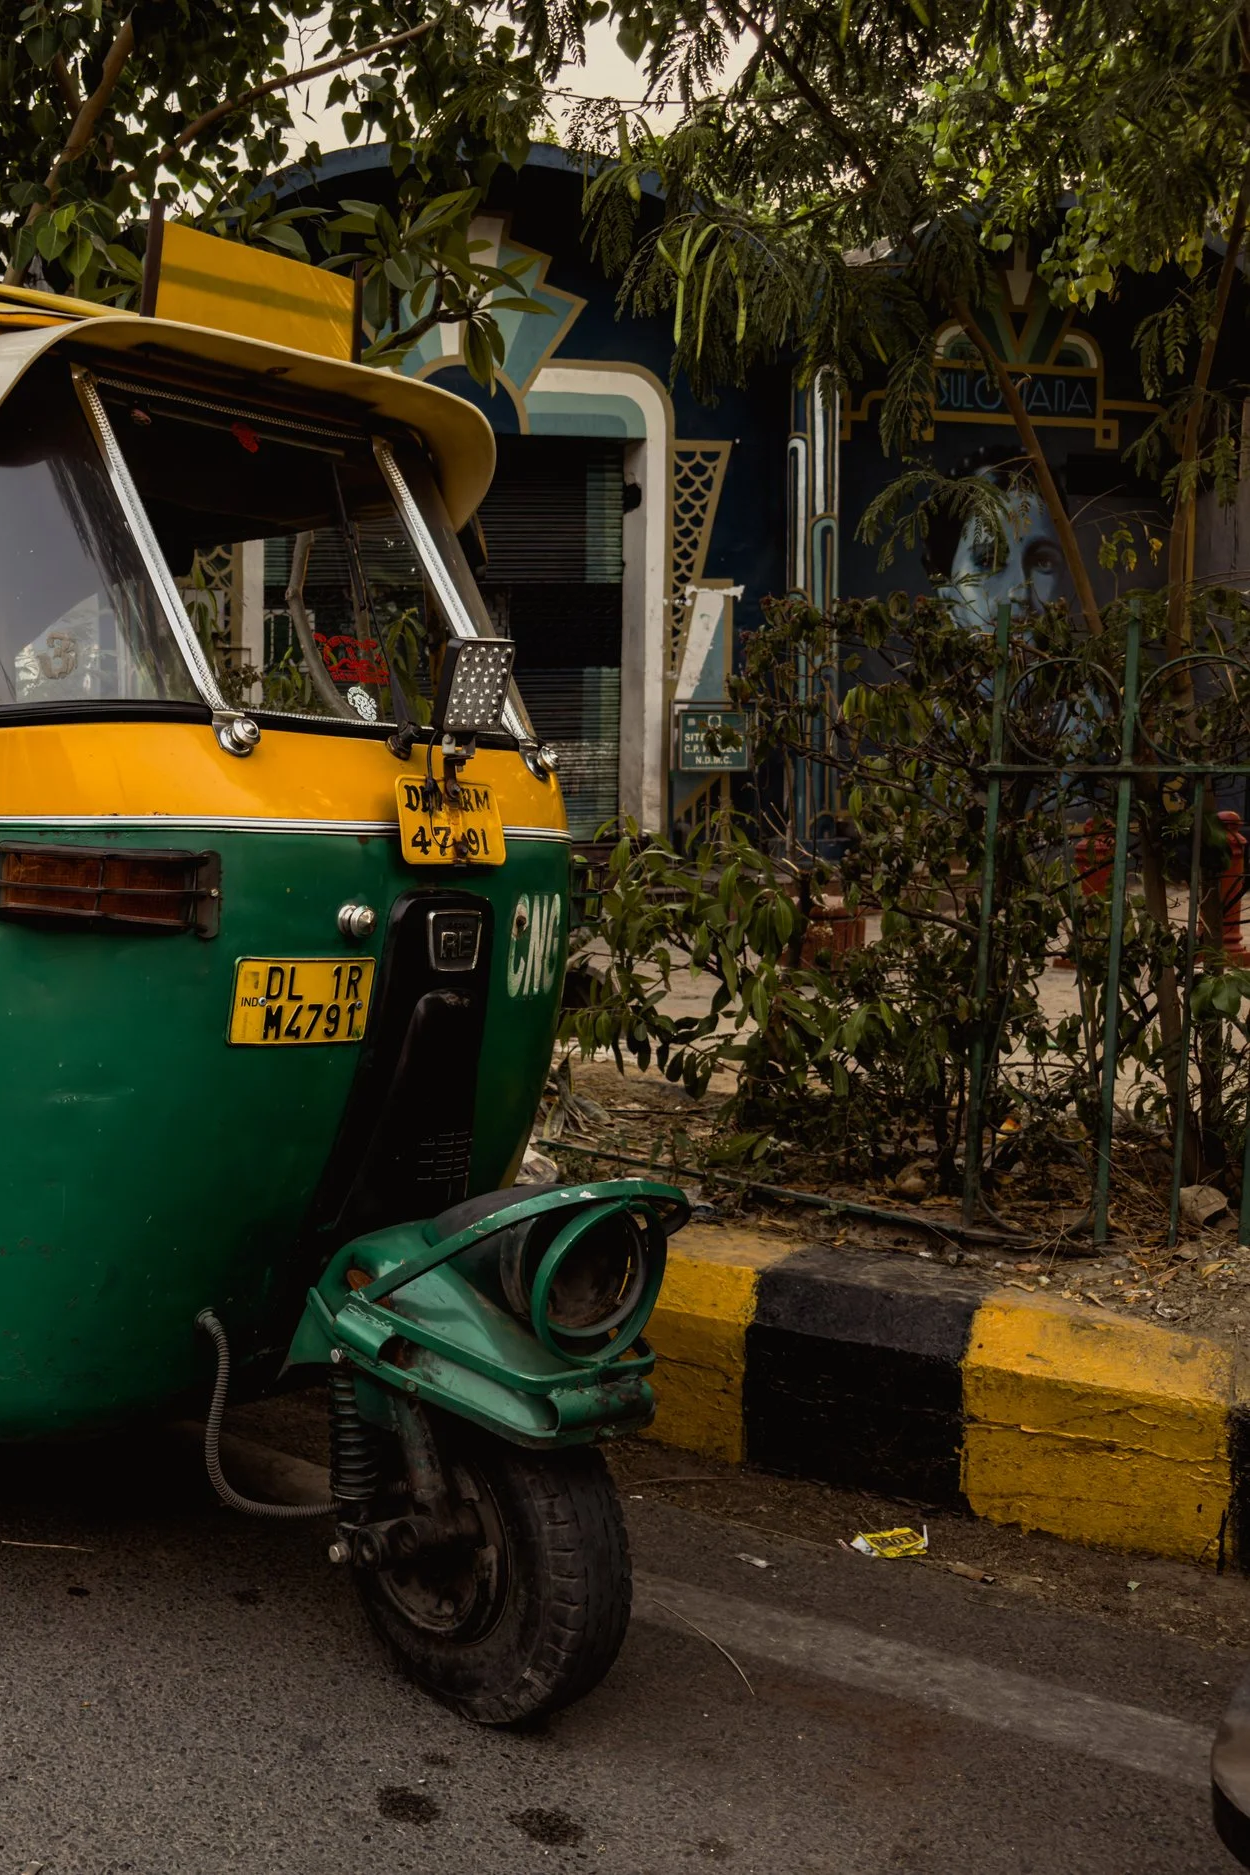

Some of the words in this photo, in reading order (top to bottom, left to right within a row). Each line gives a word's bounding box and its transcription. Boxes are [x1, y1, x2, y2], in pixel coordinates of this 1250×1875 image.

[411, 825, 490, 857] 4791
[507, 893, 561, 998] CNG
[265, 964, 303, 1001] DL
[333, 964, 363, 999] 1R
[241, 997, 259, 1007] IND
[262, 1001, 357, 1040] M4791
